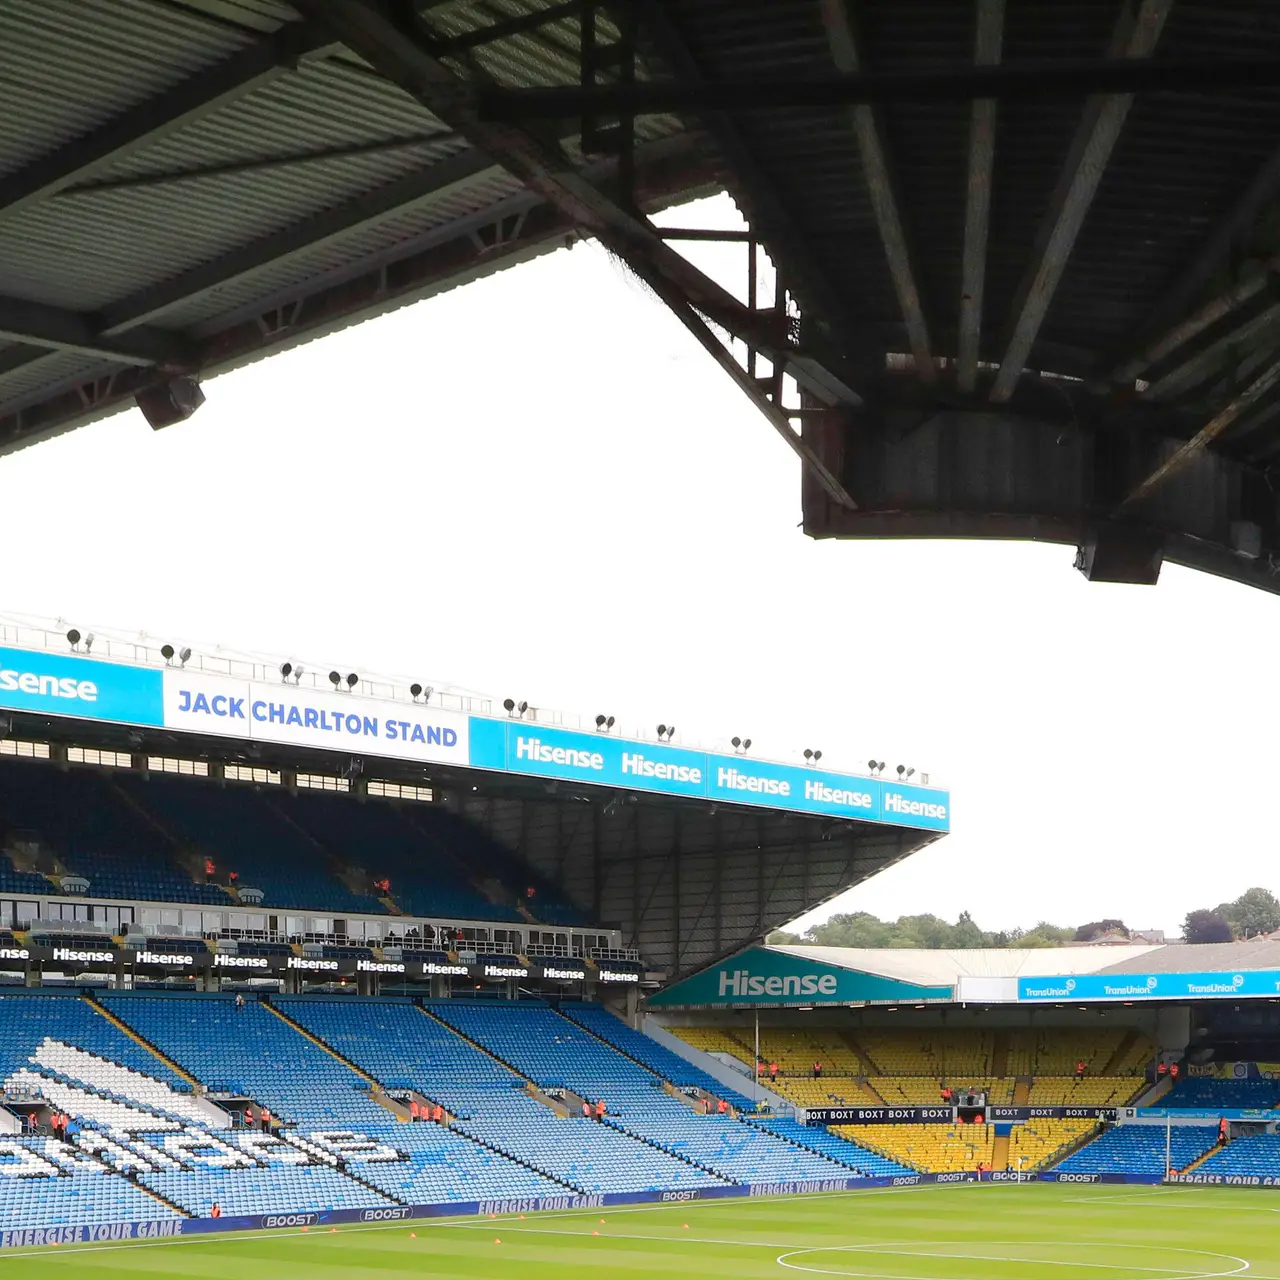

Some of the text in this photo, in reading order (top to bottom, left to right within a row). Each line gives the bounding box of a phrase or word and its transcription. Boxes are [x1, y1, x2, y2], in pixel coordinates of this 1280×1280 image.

[177, 689, 459, 749] JACK CHARLTON STAND
[516, 736, 605, 770] Hisense
[622, 752, 702, 785] Hisense
[717, 766, 791, 796] Hisense
[804, 779, 872, 808] Hisense
[885, 791, 947, 819] Hisense
[53, 948, 114, 963] Hisense
[136, 951, 194, 965] Hisense
[214, 954, 269, 968] Hisense
[287, 957, 339, 970] Hisense
[357, 960, 405, 973] Hisense
[422, 963, 469, 975] Hisense
[484, 966, 528, 977] Hisense
[543, 968, 585, 980] Hisense
[599, 971, 639, 982] Hisense
[720, 970, 837, 997] Hisense
[1104, 984, 1151, 995] TransUnion
[1187, 983, 1236, 993] TransUnion
[1025, 987, 1070, 997] TransUnion
[806, 1109, 951, 1120] BOXT BOXT BOXT BOXT BOXT
[893, 1175, 920, 1186] BOOST
[937, 1172, 966, 1183] BOOST
[1059, 1172, 1098, 1183] BOOST
[749, 1179, 848, 1197] ENERGISE YOUR GAME
[662, 1190, 697, 1201] BOOST
[478, 1194, 604, 1216] ENERGISE YOUR GAME
[266, 1213, 315, 1228] BOOST
[364, 1207, 411, 1221] BOOST
[1, 1219, 183, 1248] ENERGISE YOUR GAME
